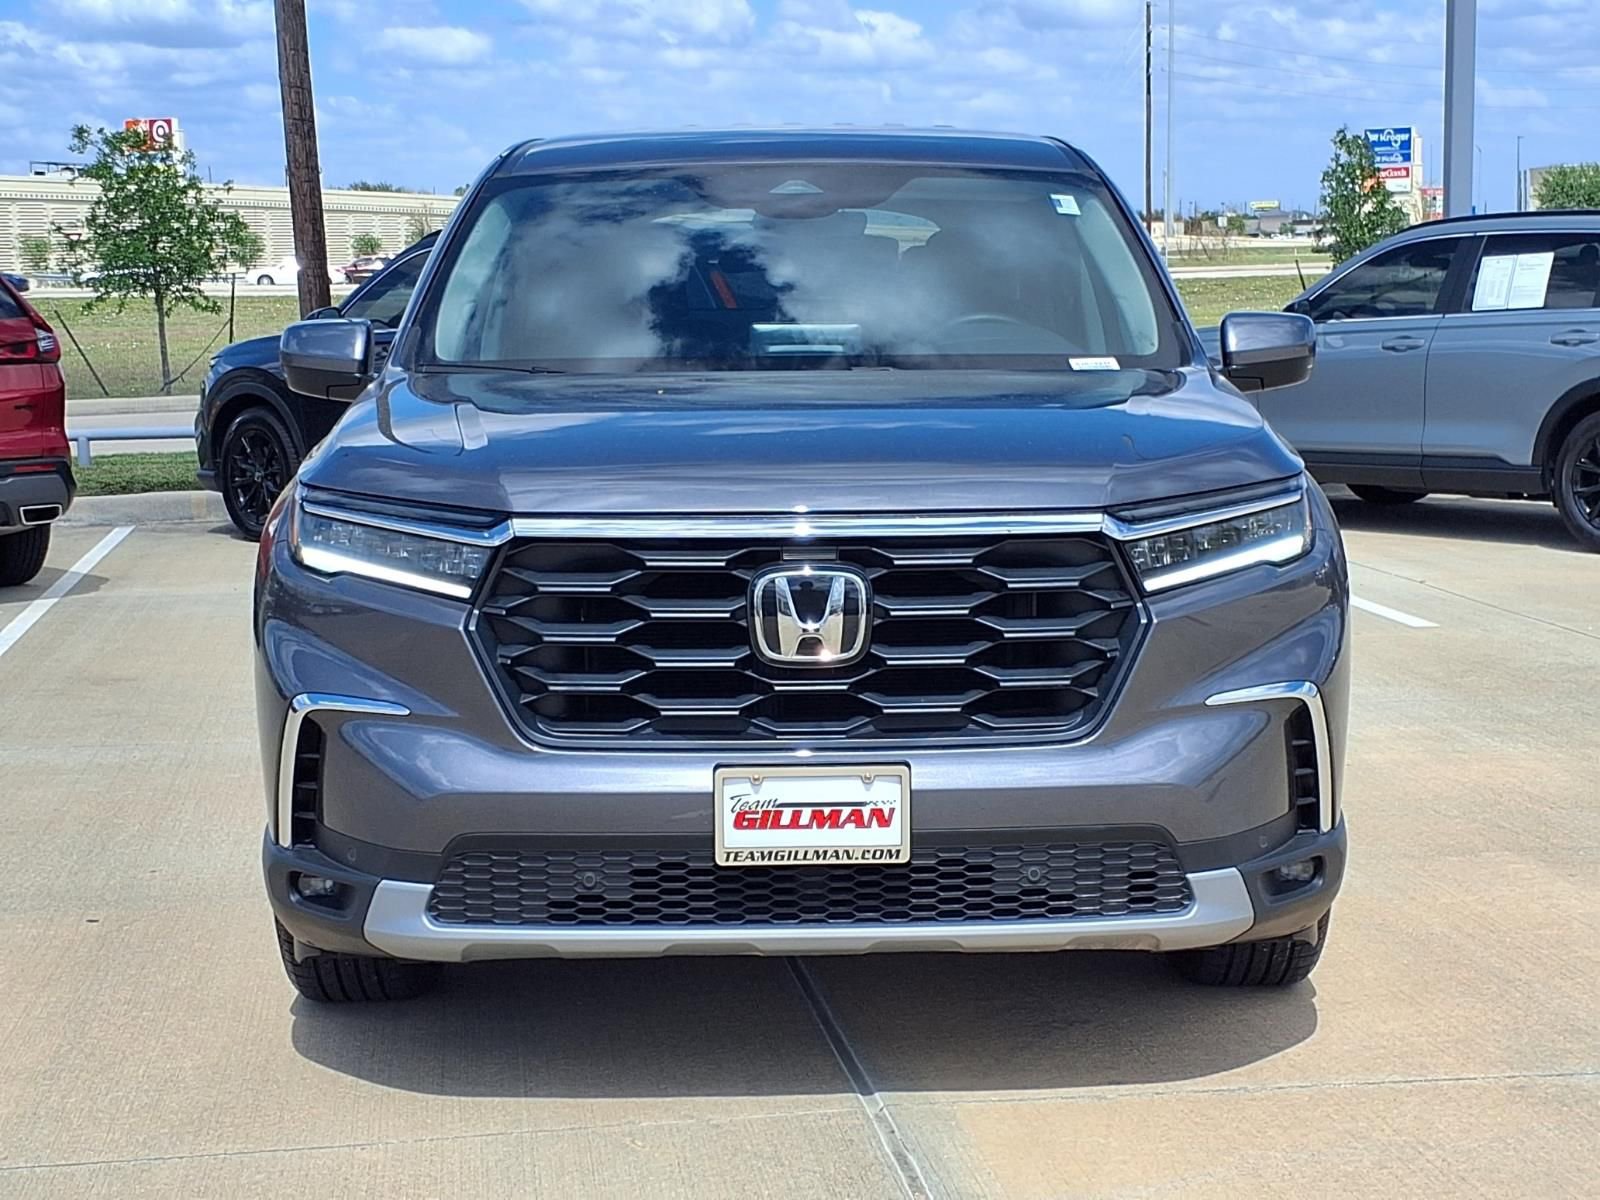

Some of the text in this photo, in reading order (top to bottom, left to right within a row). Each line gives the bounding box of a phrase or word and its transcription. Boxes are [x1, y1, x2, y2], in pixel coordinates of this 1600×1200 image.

[1379, 129, 1410, 148] Kroger
[729, 793, 779, 814] Team
[733, 808, 896, 830] GILLMAN
[723, 848, 901, 863] TEAMGILLMAN.COM
